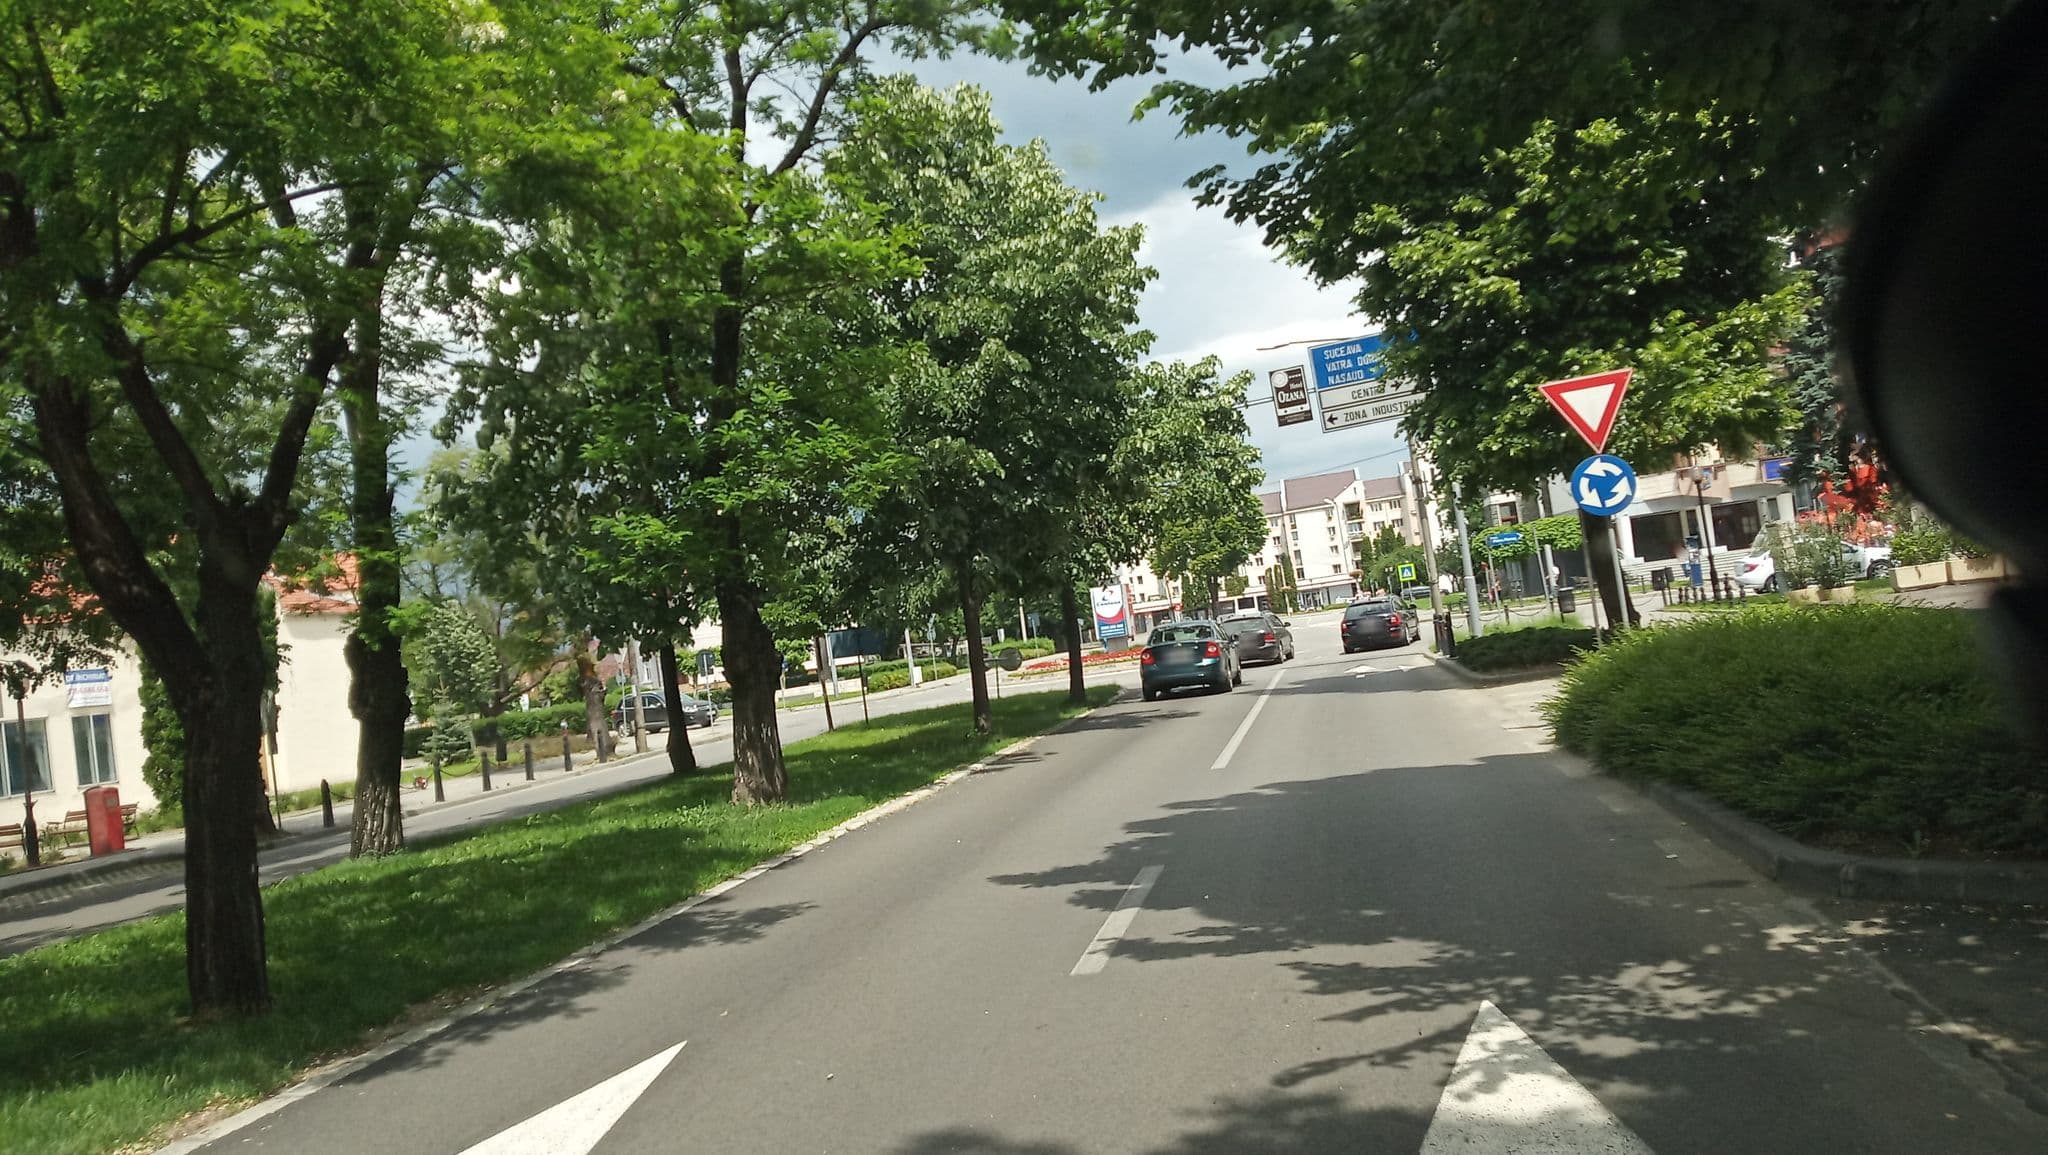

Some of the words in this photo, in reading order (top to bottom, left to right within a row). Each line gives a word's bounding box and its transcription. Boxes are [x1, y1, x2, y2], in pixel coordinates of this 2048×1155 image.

[1323, 344, 1362, 360] SUCEAVA
[1326, 359, 1353, 372] VATRA
[1328, 370, 1364, 385] NASAUD
[1351, 385, 1385, 400] CENTR
[1343, 410, 1368, 422] ZONA
